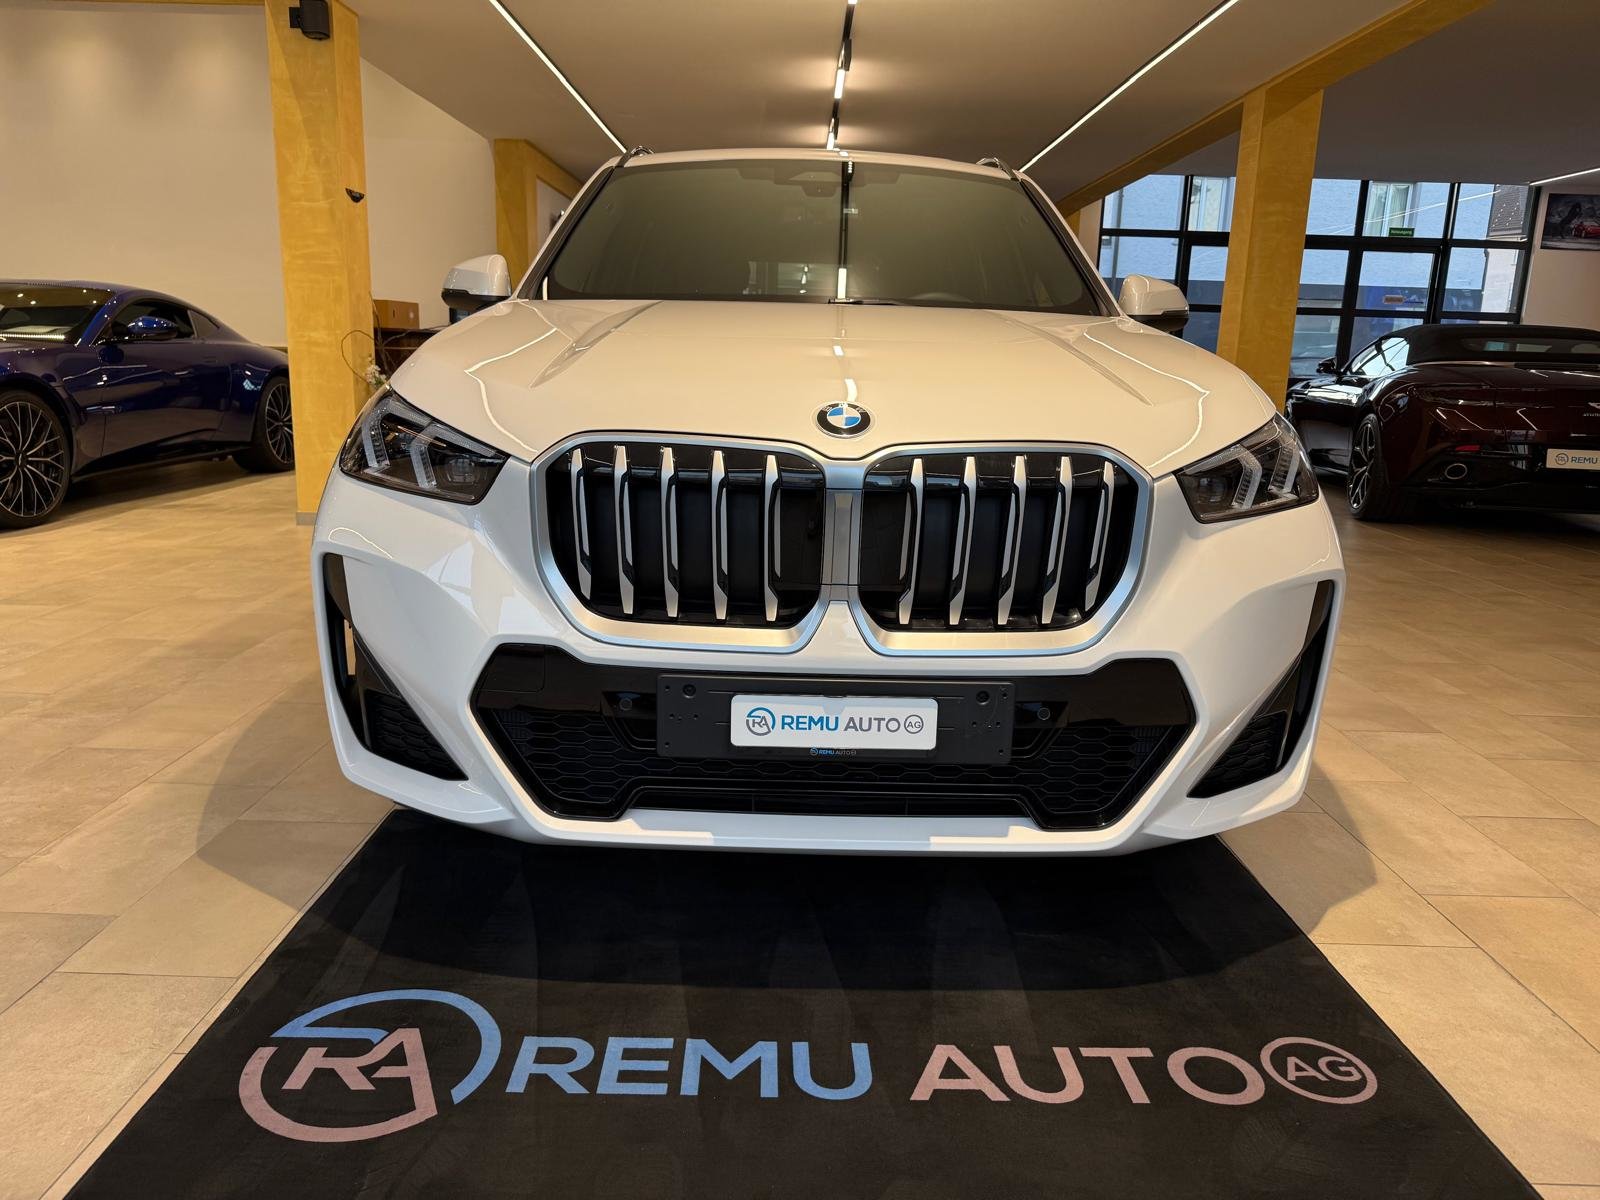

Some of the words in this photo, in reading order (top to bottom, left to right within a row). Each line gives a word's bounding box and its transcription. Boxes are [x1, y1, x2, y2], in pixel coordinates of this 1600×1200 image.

[1571, 456, 1598, 464] REMU
[781, 715, 839, 731] REMU
[844, 716, 901, 733] AUTO
[505, 1036, 873, 1100] REMU
[909, 1044, 1266, 1106] AUTO
